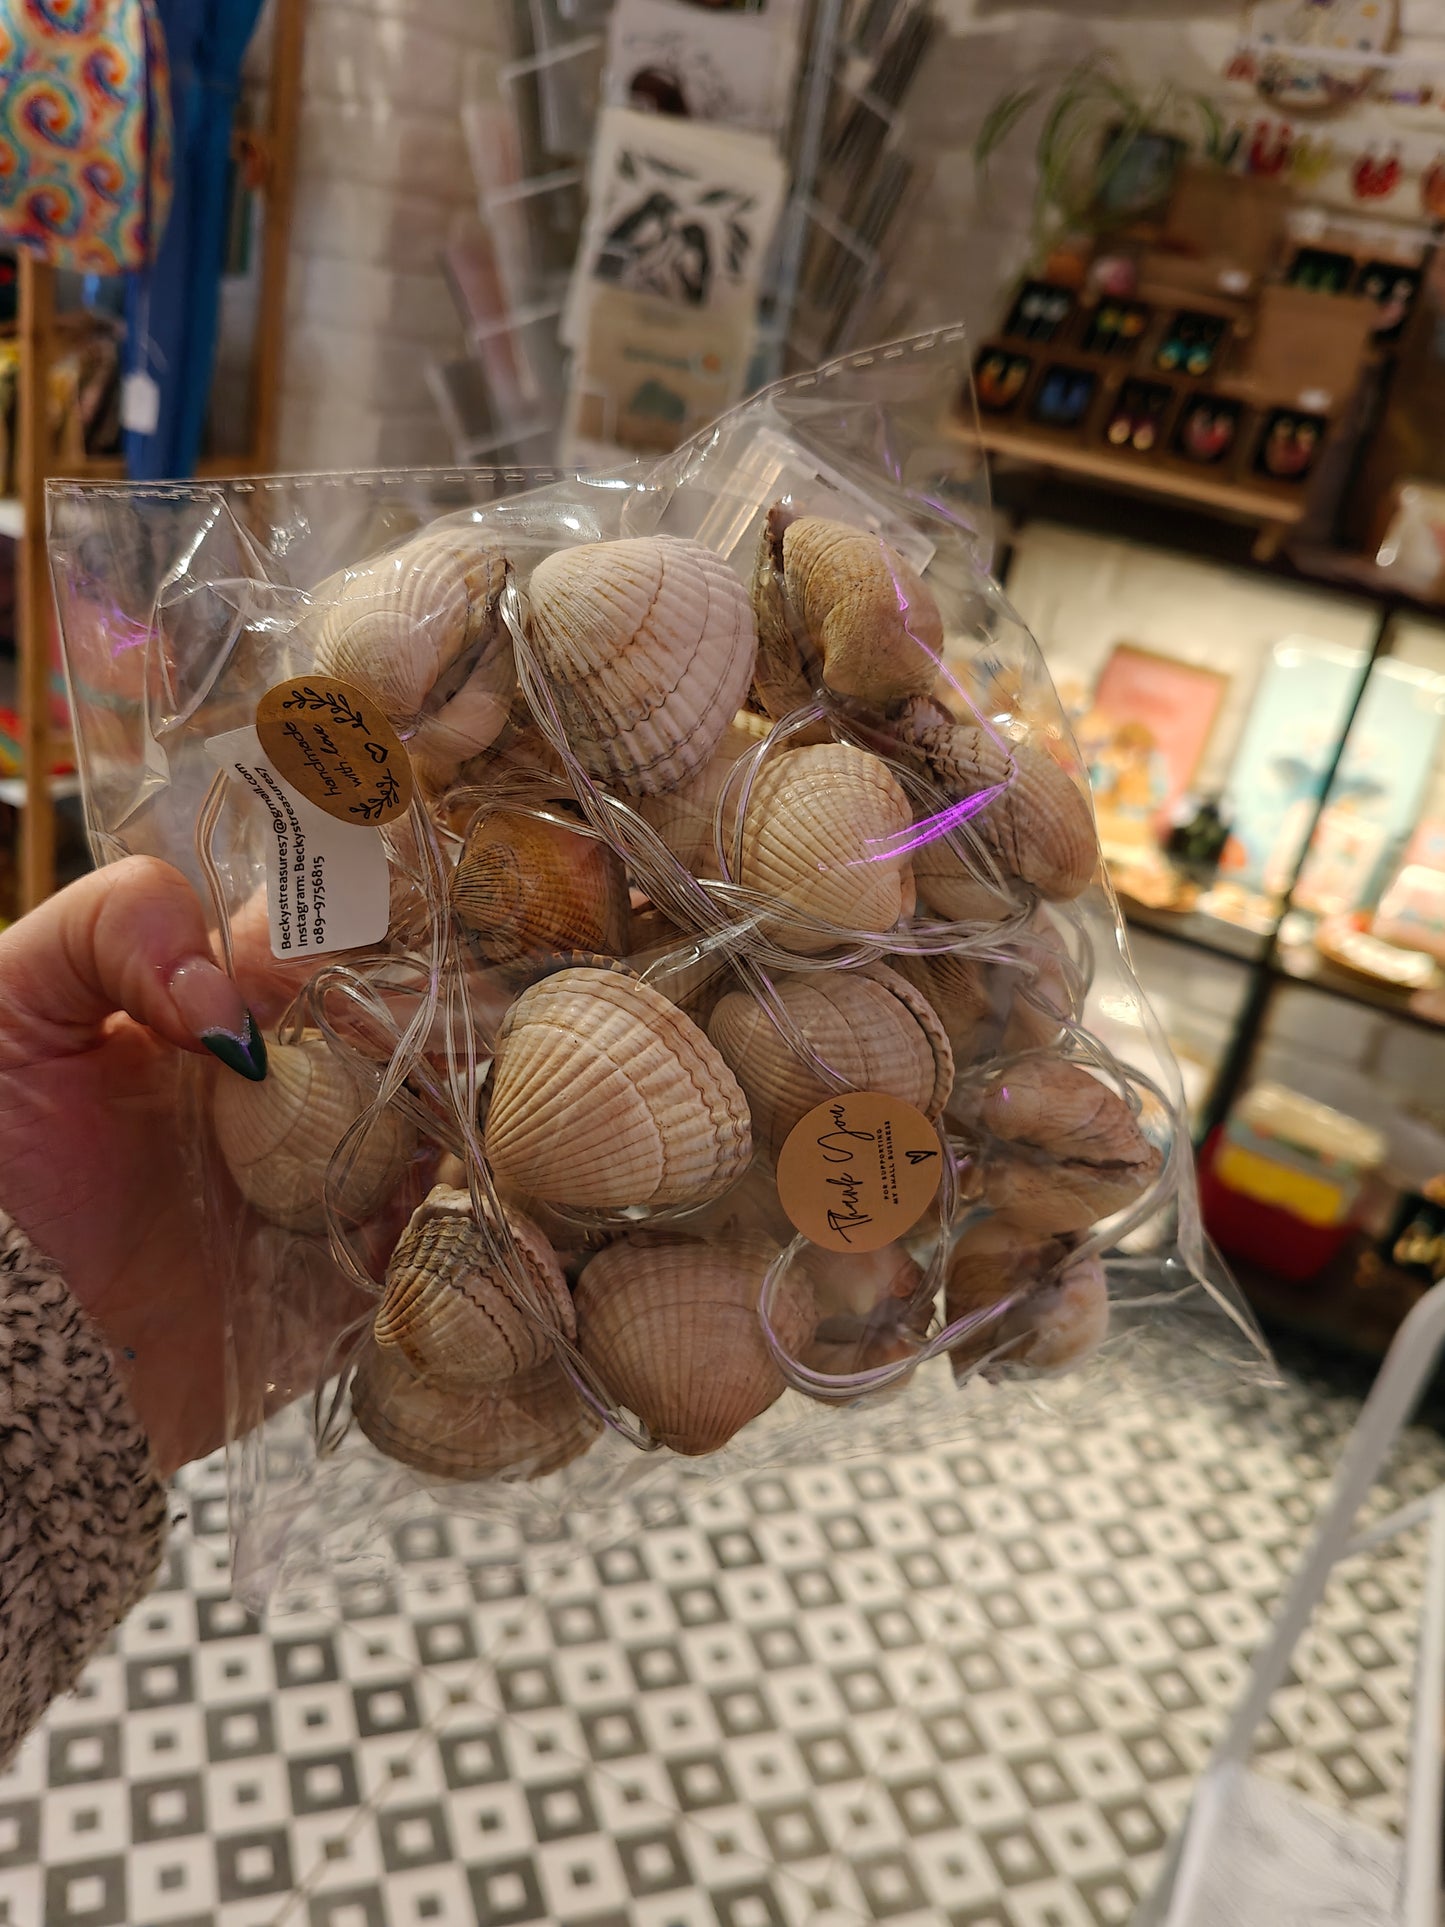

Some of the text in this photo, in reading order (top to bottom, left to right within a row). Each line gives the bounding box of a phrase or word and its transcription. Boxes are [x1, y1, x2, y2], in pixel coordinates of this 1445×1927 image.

[282, 721, 341, 796] handmade
[312, 723, 362, 788] with love
[233, 762, 292, 950] Beckystreasures7@gmail.com
[254, 766, 309, 947] Instagram: Beckystreasures7
[817, 1104, 875, 1244] Thank You
[876, 1128, 890, 1200] FOR SUPPORTING
[884, 1120, 899, 1205] MY SMALL BUSINESS
